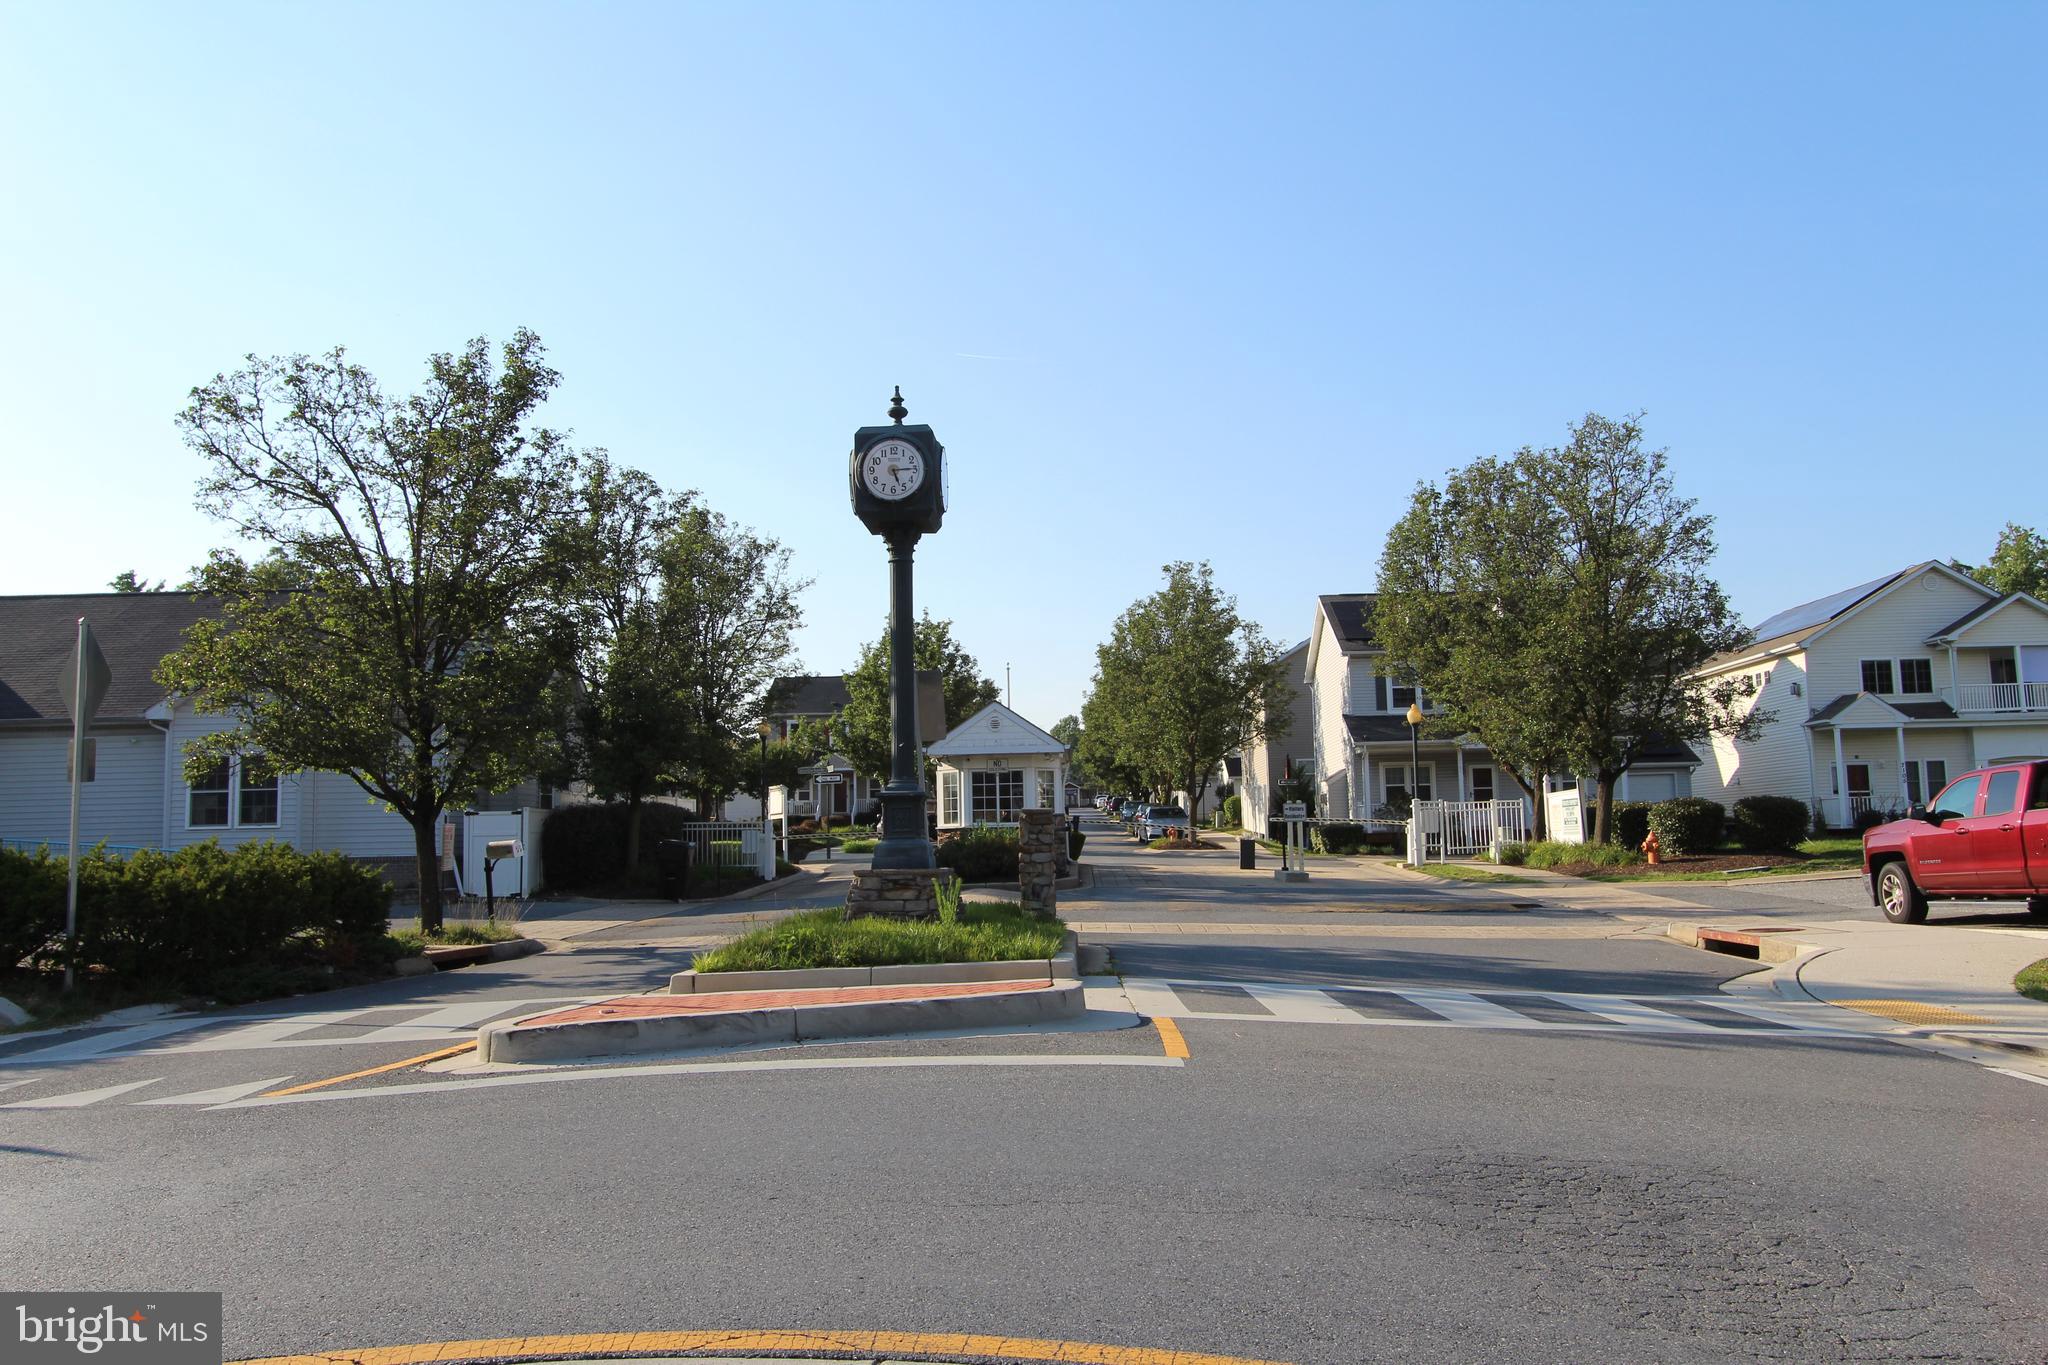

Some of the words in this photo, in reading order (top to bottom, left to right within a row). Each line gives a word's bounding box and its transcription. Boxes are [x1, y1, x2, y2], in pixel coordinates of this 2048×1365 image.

[881, 449, 887, 458] 11
[890, 446, 898, 455] 12
[872, 457, 881, 466] 10
[909, 456, 915, 464] 2
[869, 466, 875, 475] 9
[873, 476, 879, 485] 8
[881, 483, 887, 492] 7
[890, 486, 897, 494] 6
[901, 483, 907, 491] 5
